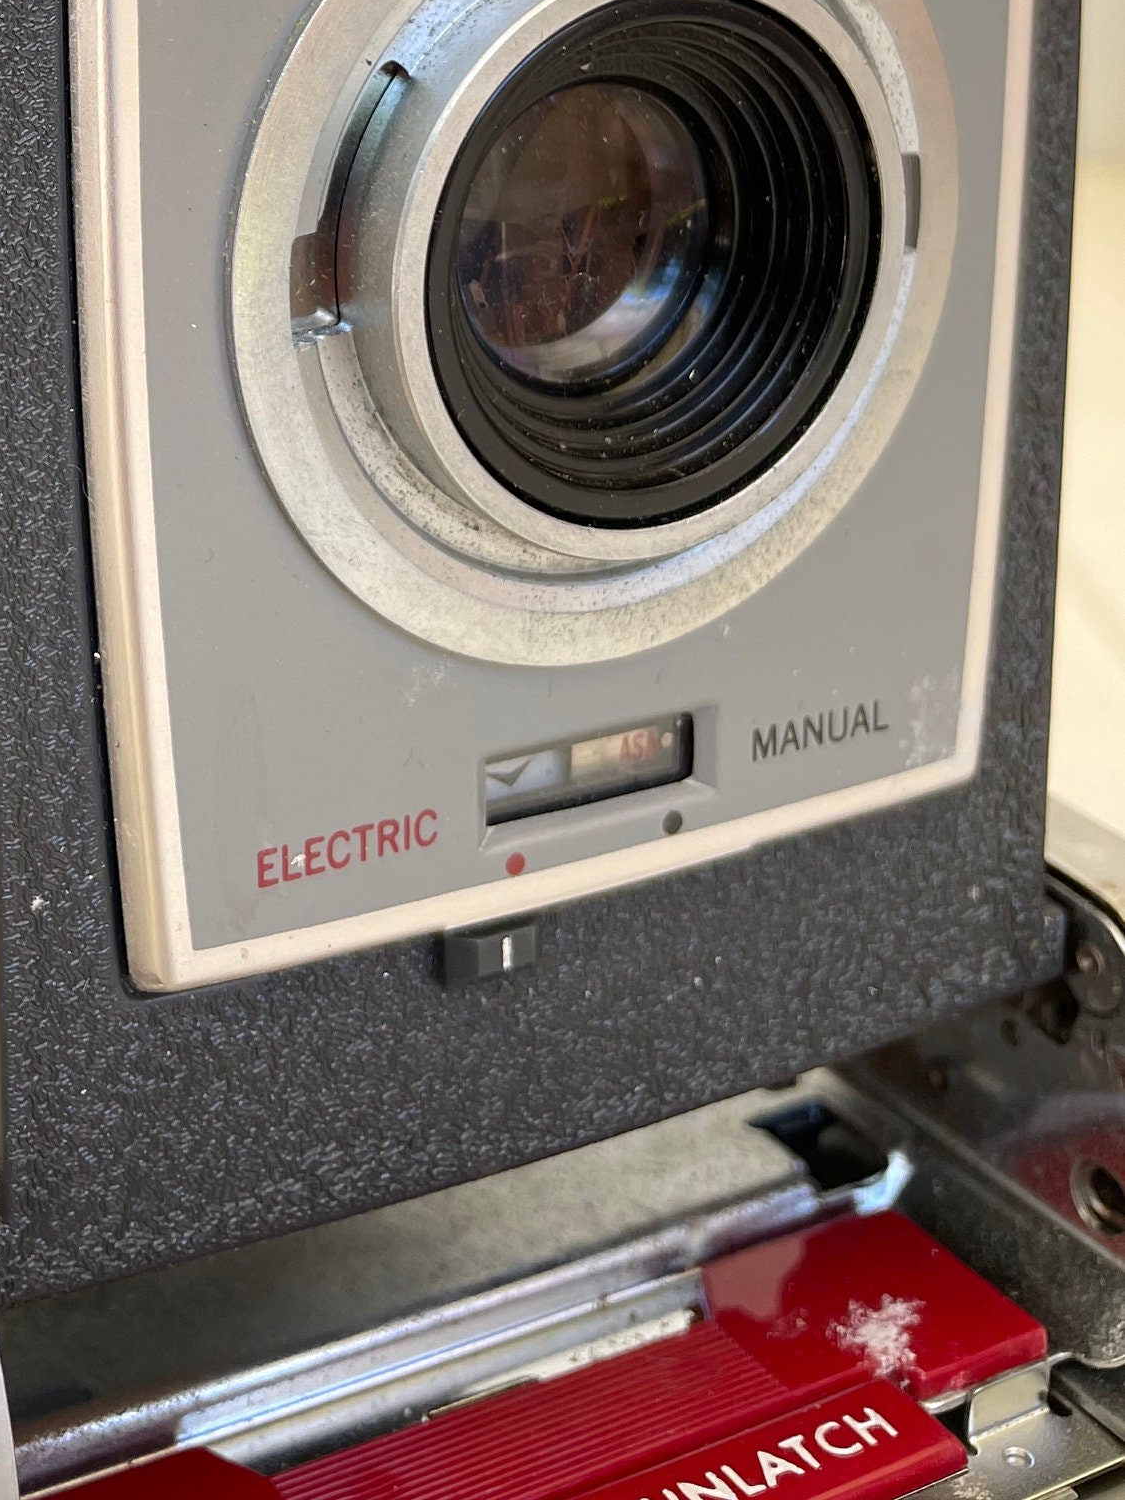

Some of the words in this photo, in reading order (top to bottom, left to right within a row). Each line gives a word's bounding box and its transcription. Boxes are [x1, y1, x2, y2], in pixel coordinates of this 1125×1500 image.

[751, 700, 889, 762] MANUAL
[256, 808, 438, 888] ELECTRIC
[639, 1406, 899, 1500] NLATCH
